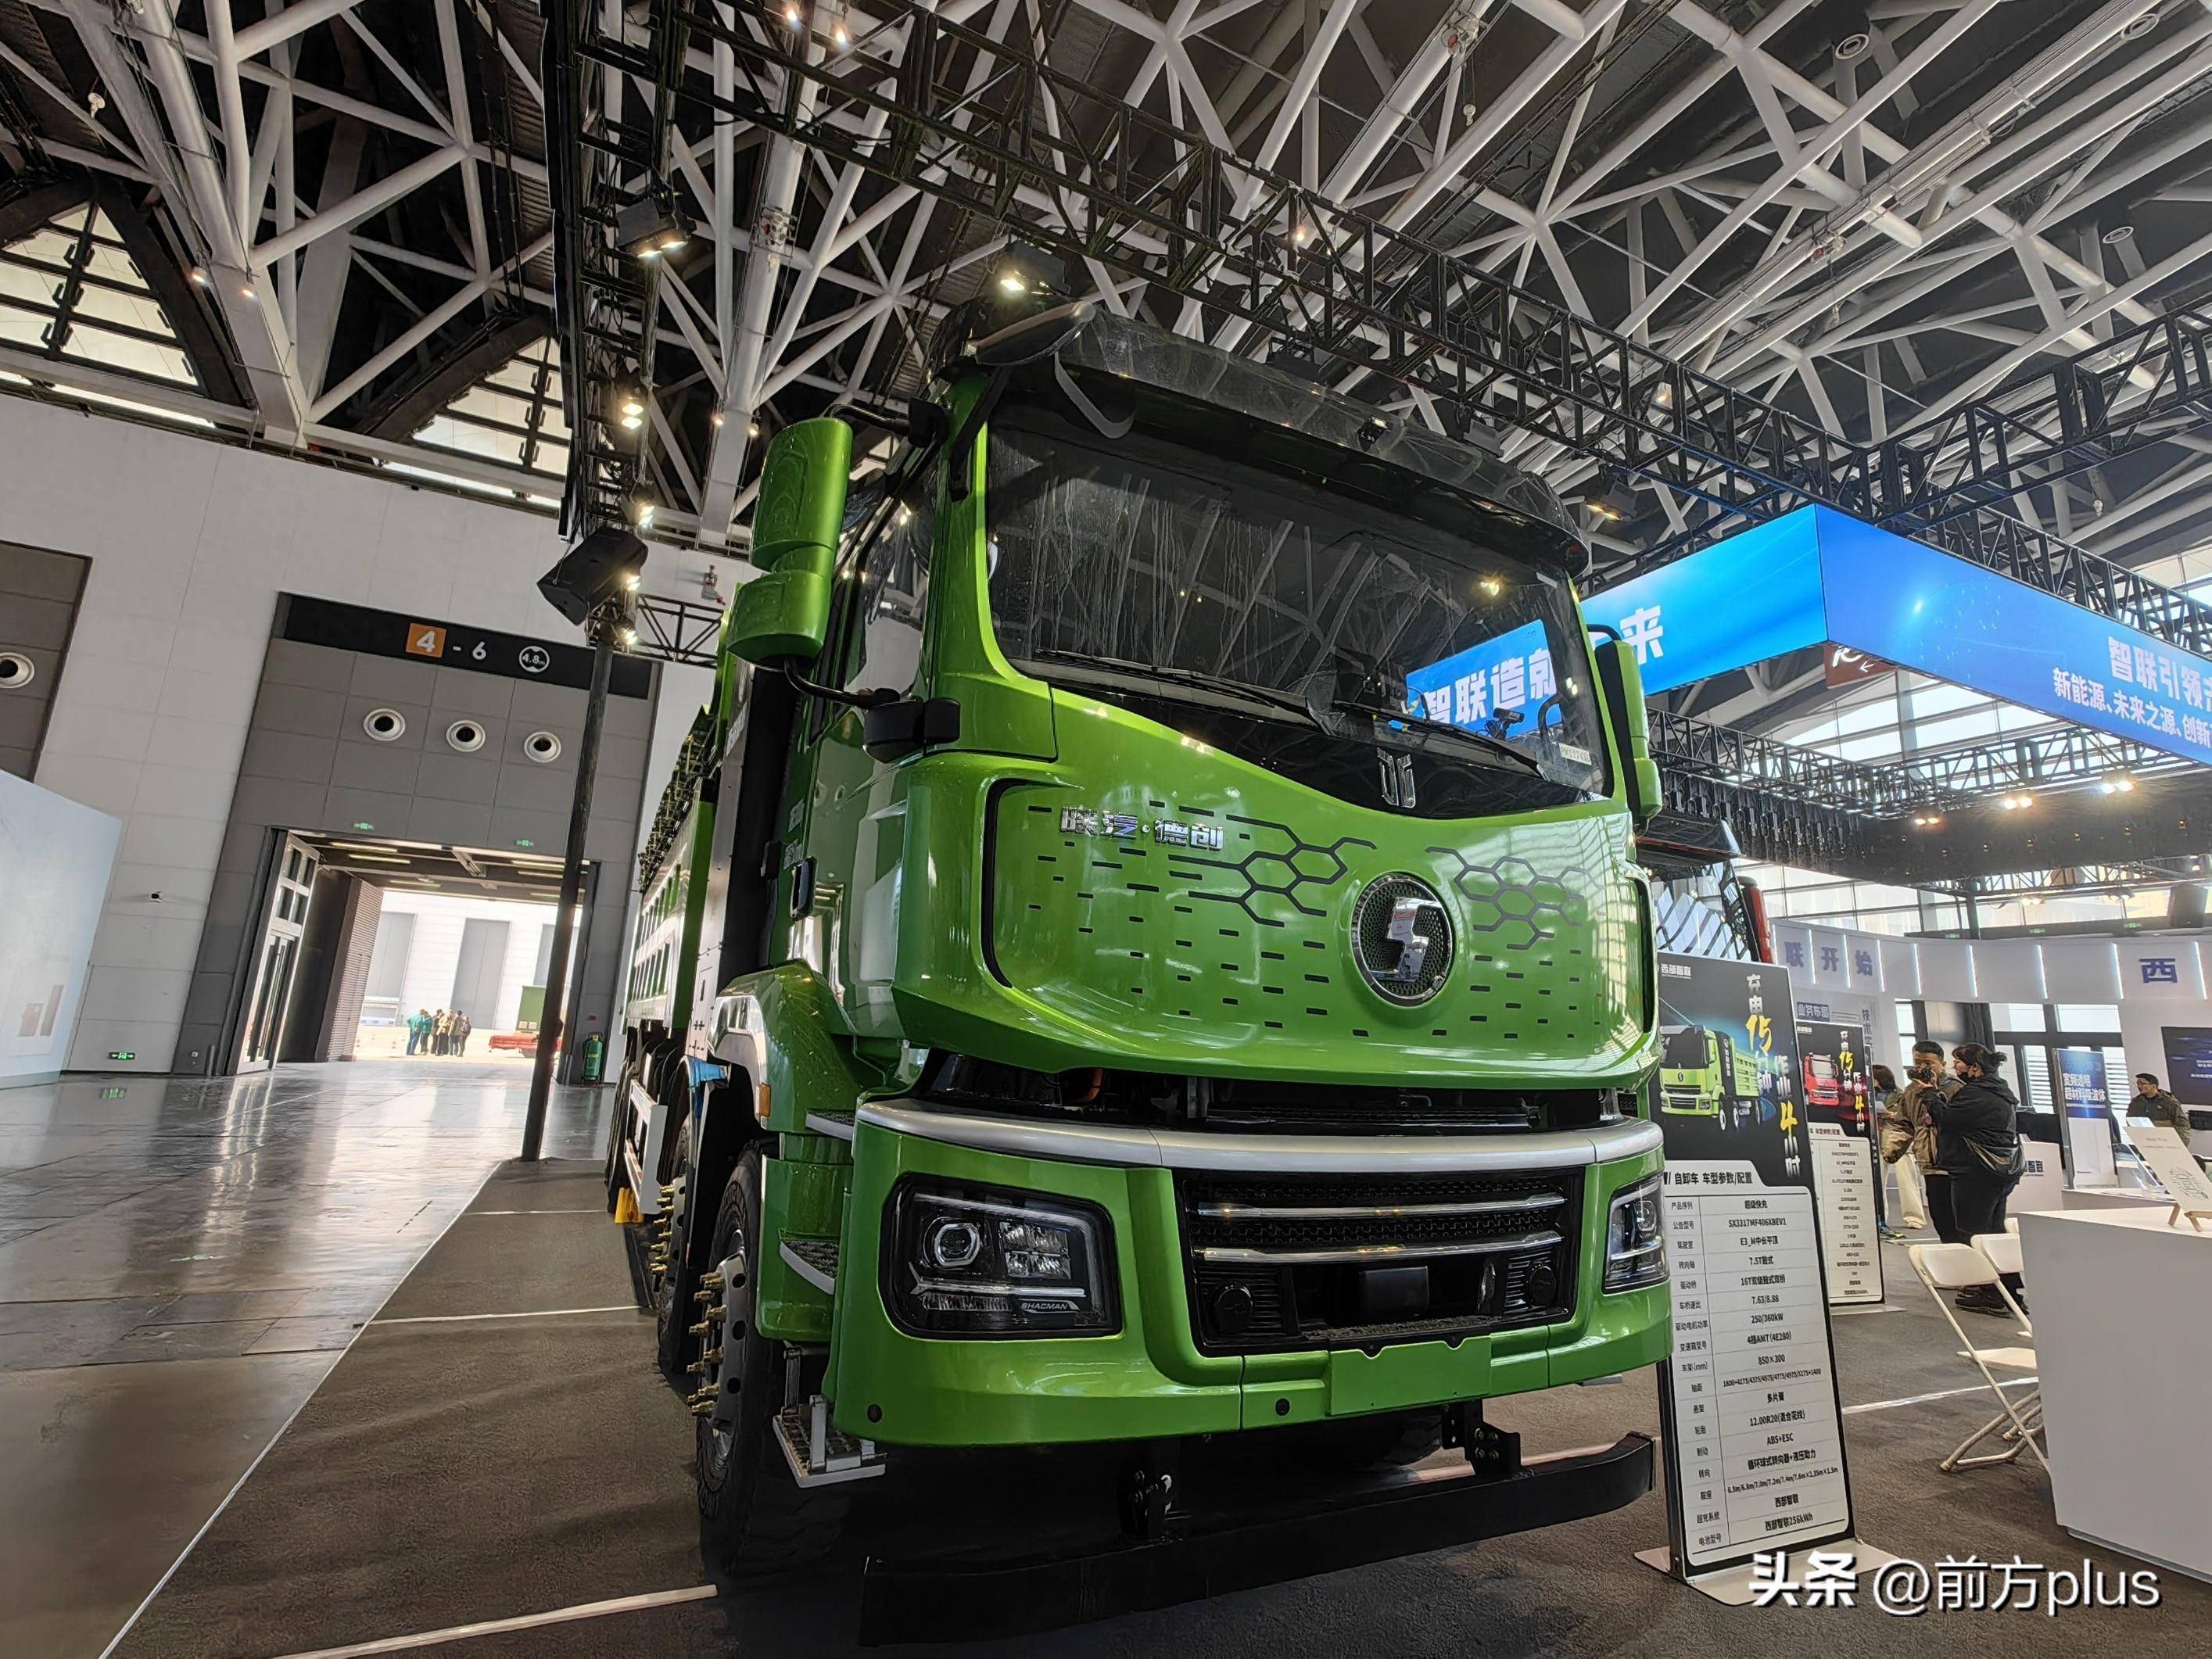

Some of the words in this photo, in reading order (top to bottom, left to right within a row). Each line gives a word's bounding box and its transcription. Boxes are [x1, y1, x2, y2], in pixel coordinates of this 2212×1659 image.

[416, 629, 437, 653] 4
[471, 640, 487, 661] 6
[2052, 667, 2212, 749] 新能源、未来之源、创新
[2139, 958, 2178, 984] 西
[1675, 1172, 1699, 1185] 自卸车
[1702, 1172, 1753, 1185] 车型参数/配置
[1020, 1302, 1069, 1310] SHACMAN
[1751, 1313, 1784, 1324] 250/360kW
[1766, 1432, 1794, 1446] ABS+ESC
